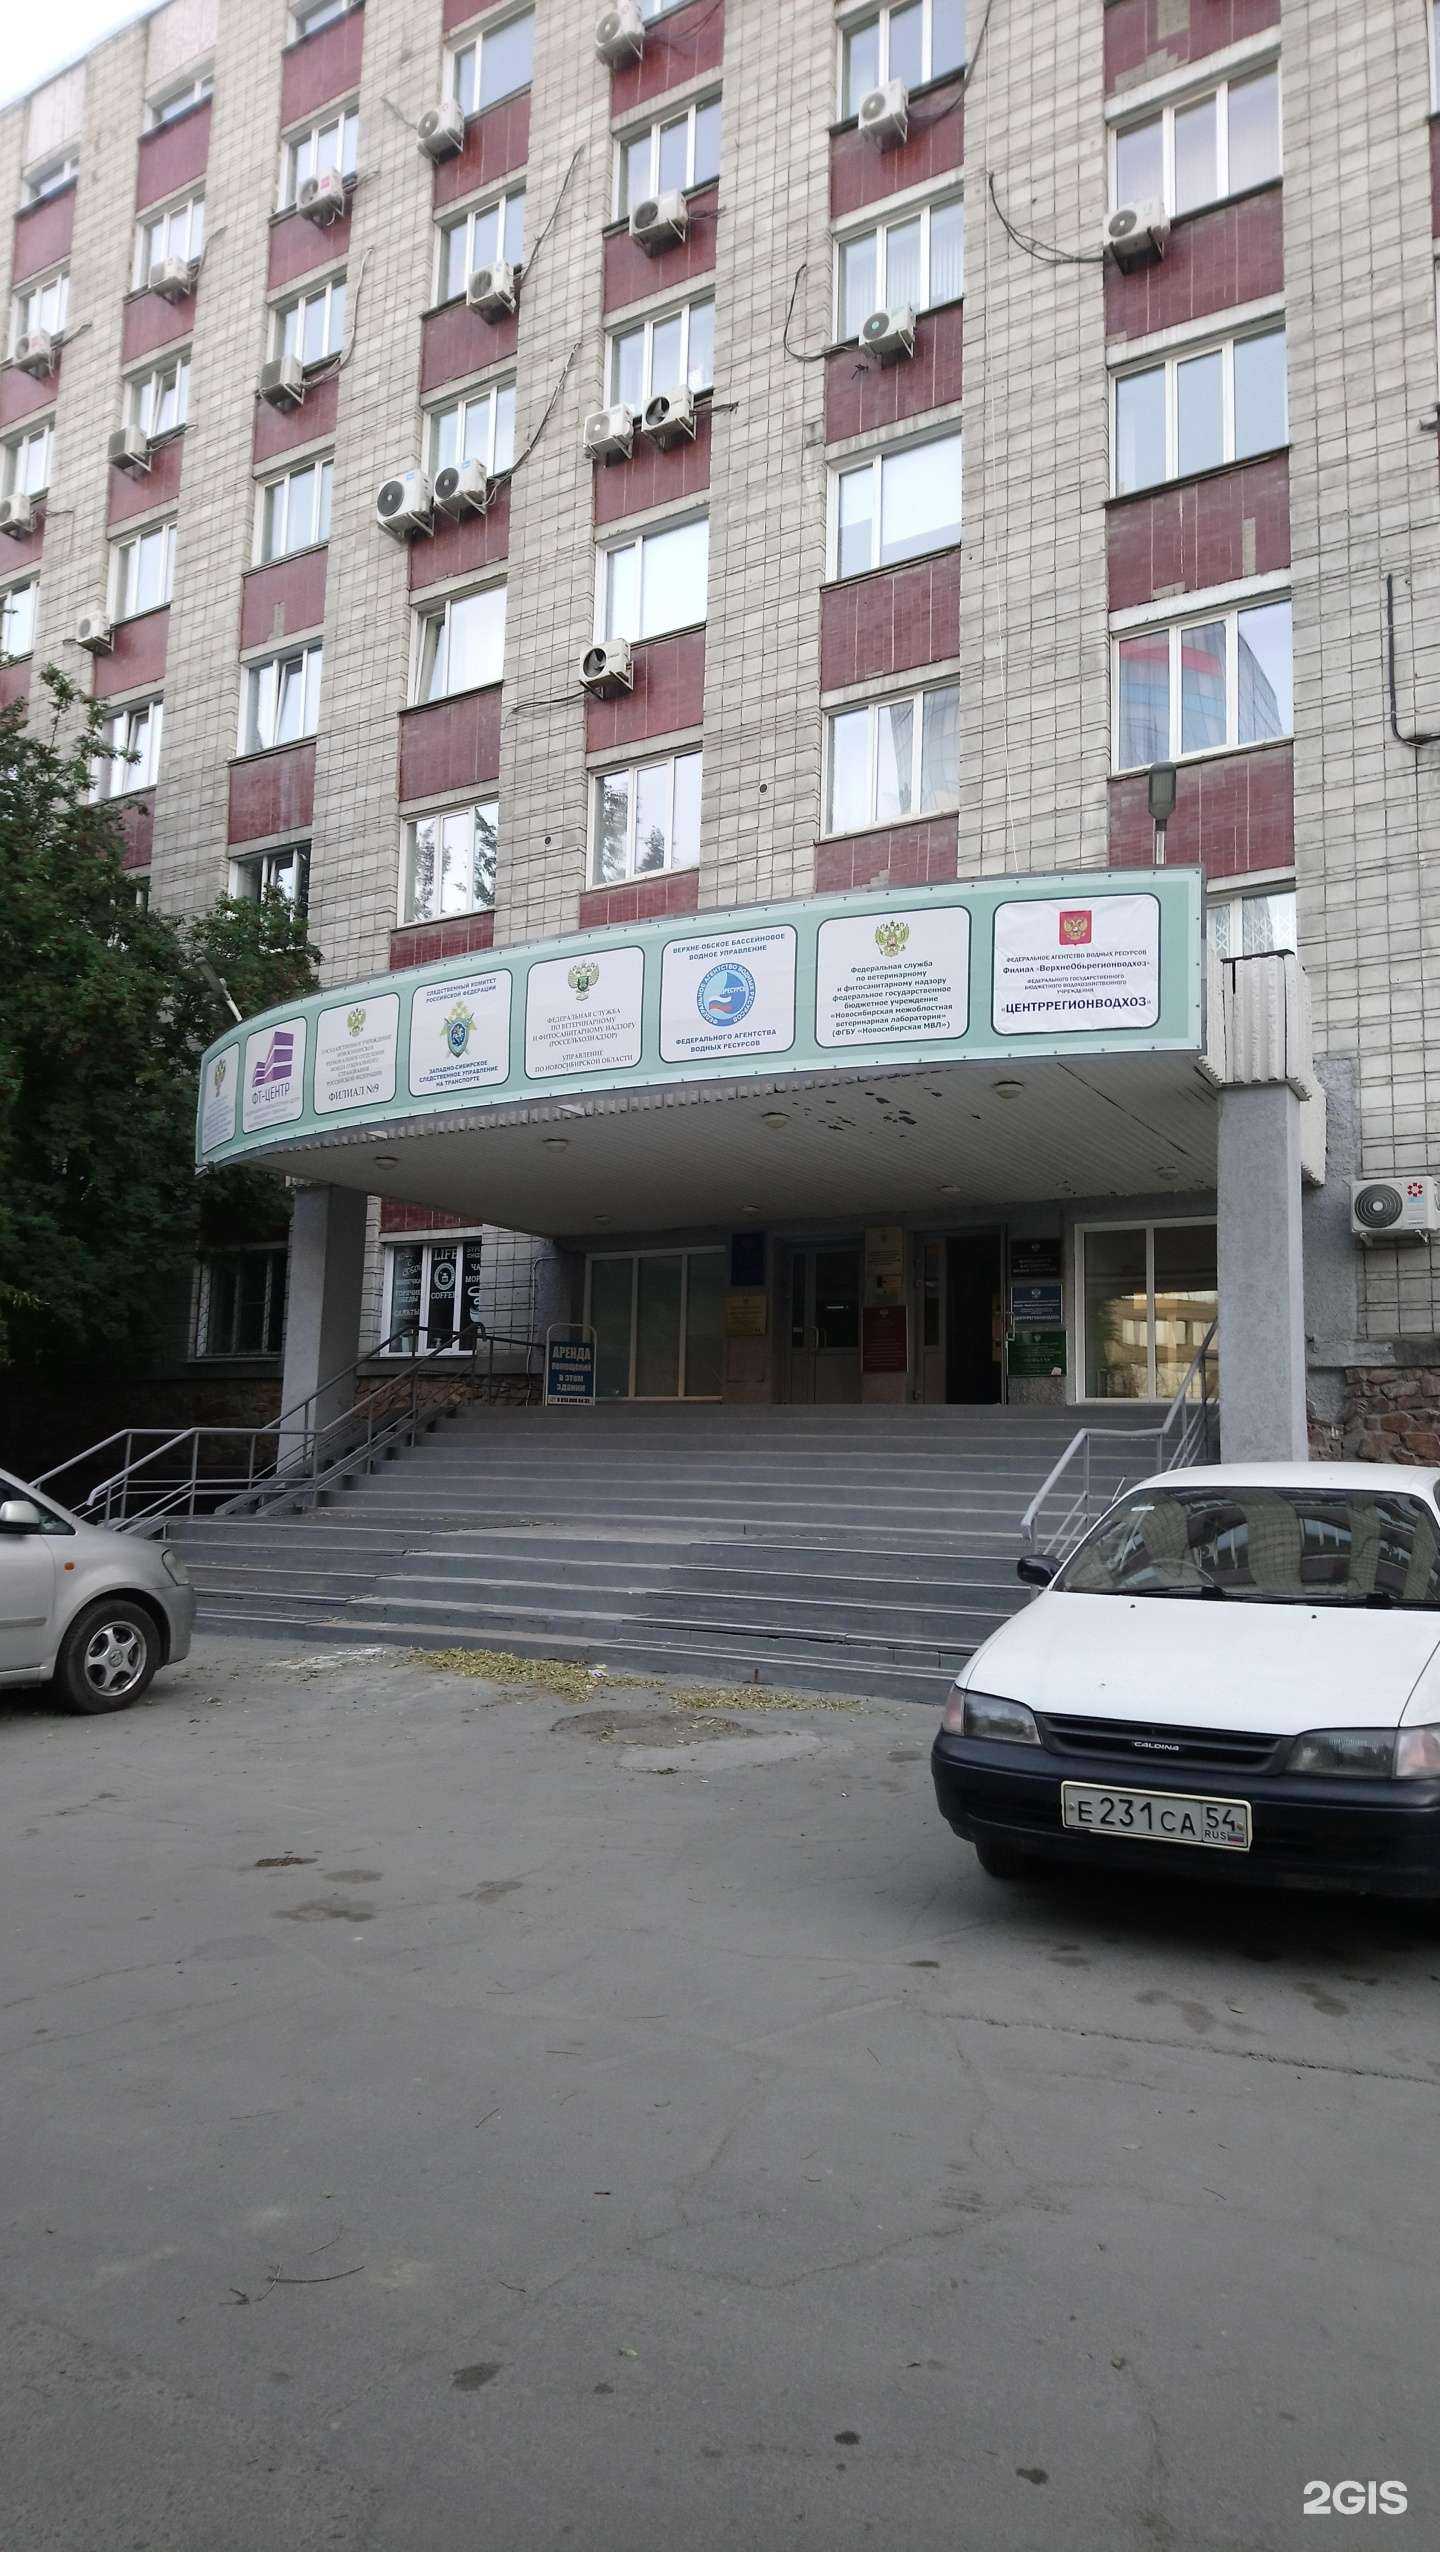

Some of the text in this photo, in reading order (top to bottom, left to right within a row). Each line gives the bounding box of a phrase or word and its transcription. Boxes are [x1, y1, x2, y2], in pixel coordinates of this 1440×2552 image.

[731, 933, 785, 946] БАССЕЙНОВОЕ
[689, 944, 767, 960] ВОДНОЕ УПРАВЛЕНИЕ
[851, 960, 933, 974] Федеральная служба
[1003, 966, 1034, 974] Филиал
[867, 970, 927, 981] ветеринарному
[1069, 974, 1125, 982] ГОСУДАРСТВЕННОГО
[427, 978, 496, 996] СЛЕДСТВЕННЫЙ КОМИТЕТ
[843, 980, 913, 993] фитосанитарному
[914, 978, 946, 987] надзору
[426, 986, 496, 1003] РОССИЙСКОЙ ФЕДЕРАЦИИ
[832, 986, 951, 1002] федеральное государственное
[844, 996, 938, 1010] бюджетное учреждение
[1001, 997, 1151, 1014] «ЦЕНТРРЕГИОНВОДХОЗ»
[546, 1008, 621, 1024] ФЕДЕРАЛЬНАЯ СЛУЖБА
[831, 1004, 953, 1019] «Новосибирская межобластная
[561, 1018, 616, 1029] ВЕТЕРИНАРНОМУ
[836, 1013, 946, 1027] ветеринарная лаборатория»
[538, 1027, 605, 1040] ФИТОСАНИТАРНОМУ
[605, 1022, 635, 1031] НАДЗОРУ
[832, 1021, 950, 1037] (ФГБУ «Новосибирская МВЛ»)
[676, 1029, 777, 1045] ФЕДЕРАЛЬНОГО АГЕНТСТВА
[690, 1040, 760, 1053] ВОДНЫХ РЕСУРСОВ
[562, 1050, 603, 1060] УПРАВЛЕНИЕ
[545, 1058, 601, 1071] НОВОСИБИРСКОЙ
[601, 1055, 633, 1064] ОБЛАСТИ
[419, 1066, 498, 1083] СЛЕДСТВЕННОЕ УПРАВЛЕНИЕ
[445, 1076, 480, 1086] ТРАНСПОРТЕ
[329, 1083, 380, 1101] ФИЛИАЛ №9
[552, 1346, 591, 1361] АРЕНДА
[1133, 1741, 1180, 1751] CALDINA
[1206, 1806, 1235, 1831] 54
[1204, 1830, 1226, 1841] RUS
